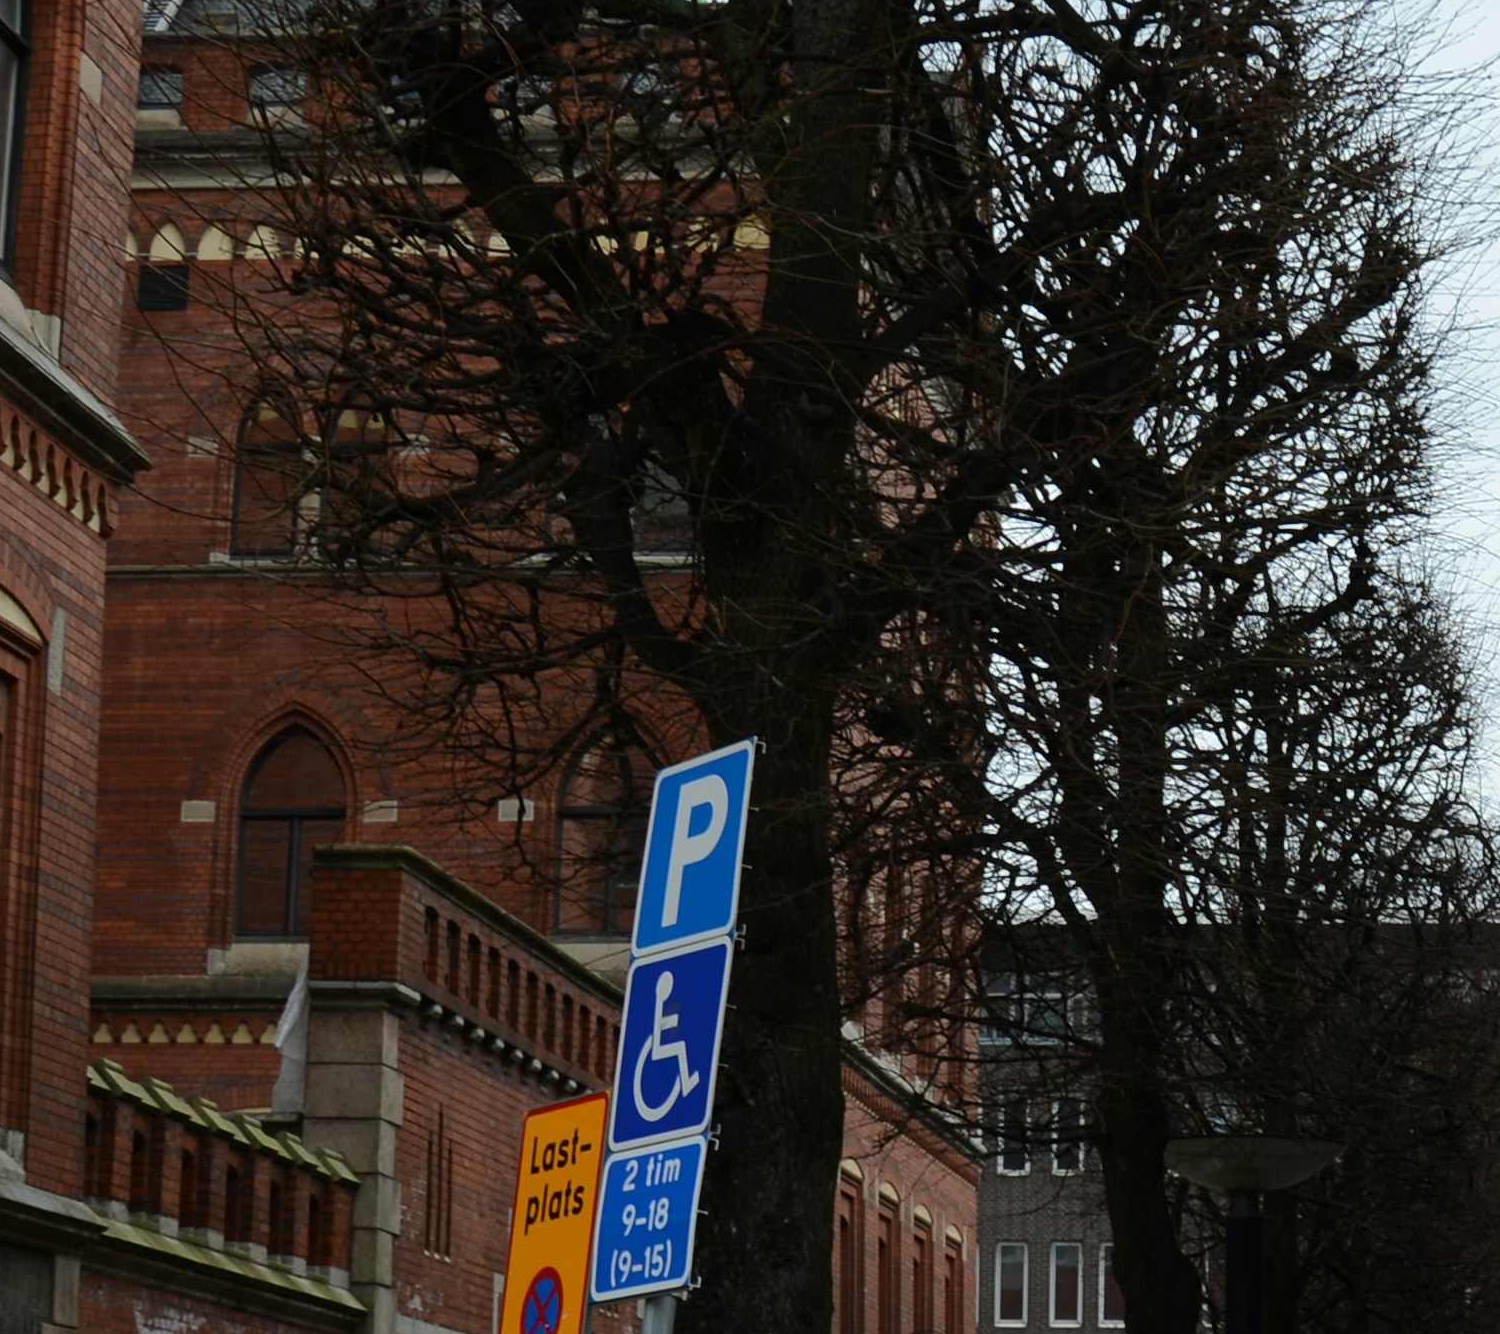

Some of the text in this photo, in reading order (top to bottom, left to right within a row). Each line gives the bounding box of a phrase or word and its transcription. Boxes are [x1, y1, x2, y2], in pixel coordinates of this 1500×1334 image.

[662, 774, 728, 927] P
[530, 1129, 591, 1175] Last-
[622, 1154, 681, 1192] 2 tim
[524, 1182, 585, 1235] plats
[621, 1197, 670, 1236] 9-18
[610, 1240, 673, 1288] (9-15)
